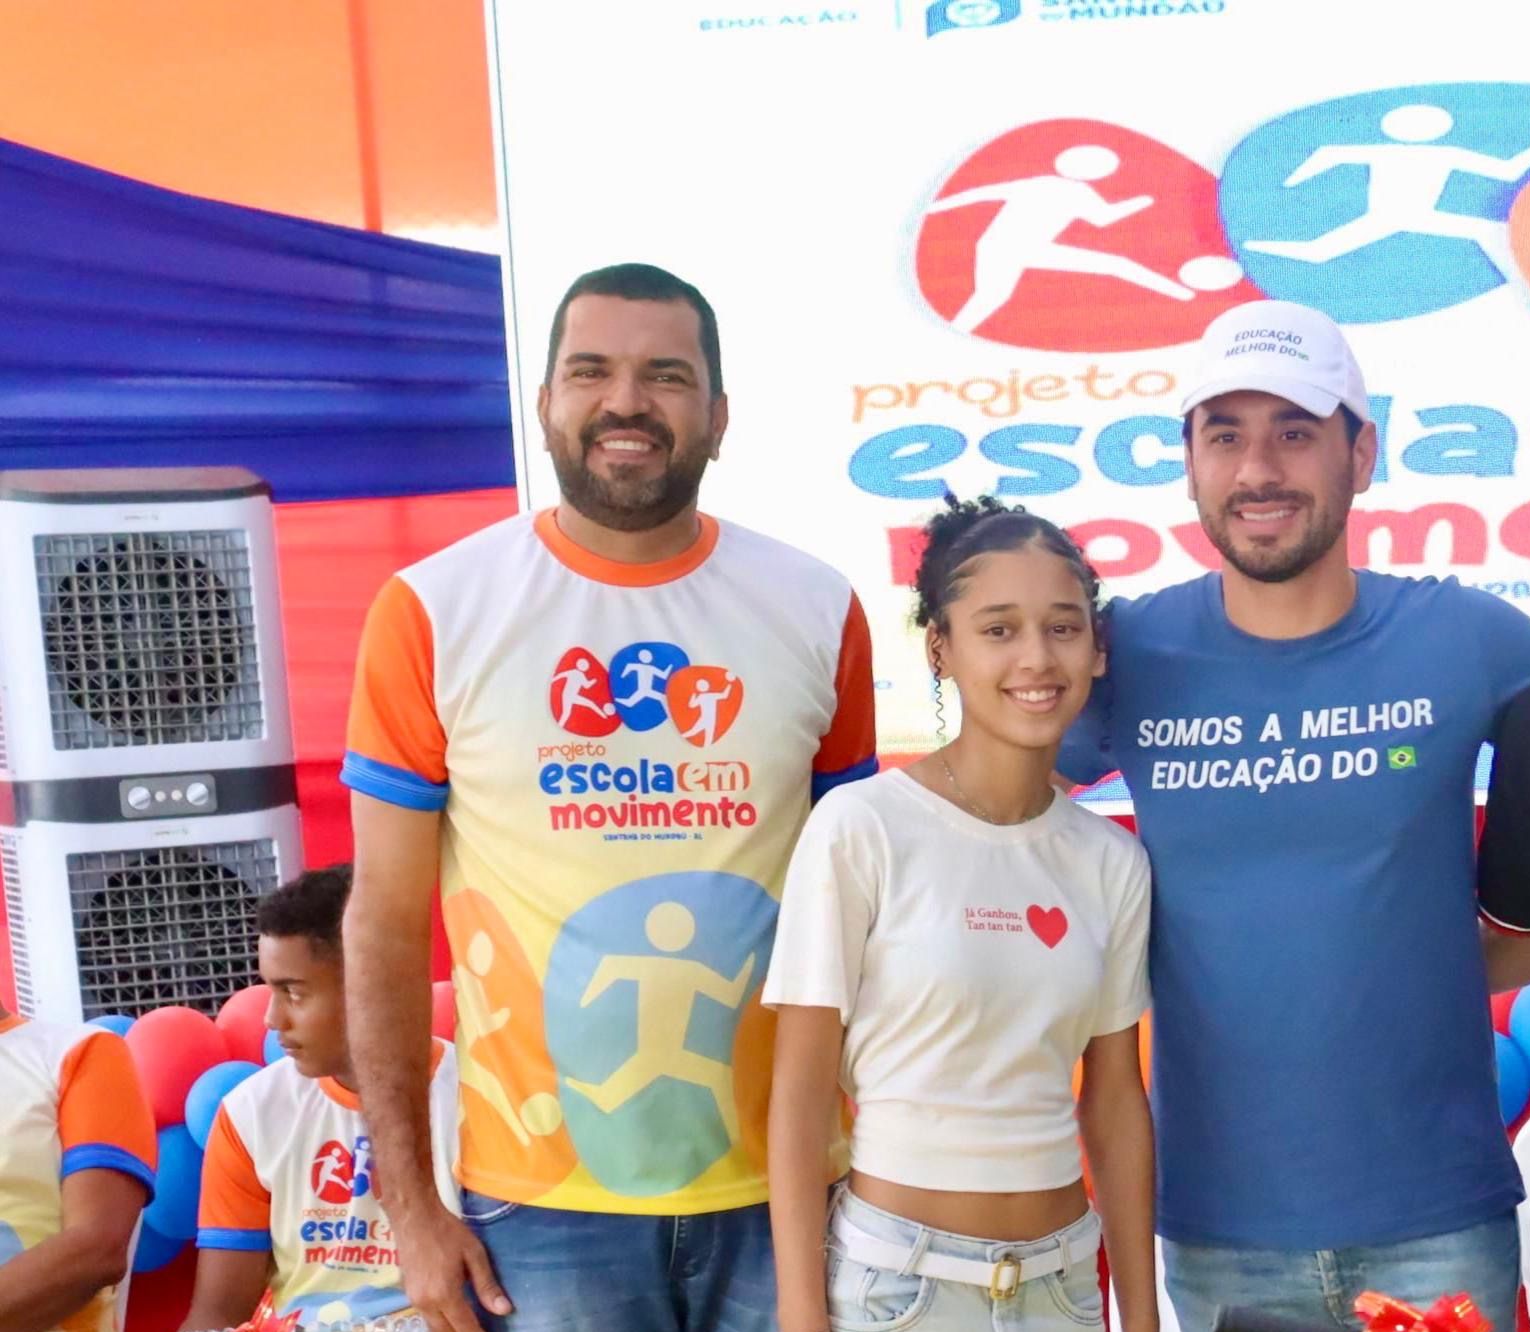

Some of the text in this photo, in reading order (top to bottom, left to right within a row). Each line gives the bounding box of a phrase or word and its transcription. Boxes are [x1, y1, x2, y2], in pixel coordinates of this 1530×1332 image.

[1224, 341, 1297, 359] MELHOR DO
[1234, 328, 1304, 346] EDUCAÇÃO
[851, 364, 1178, 423] projeto
[848, 394, 1519, 500] escla
[1137, 698, 1434, 748] SOMOS A MELHOR
[537, 741, 607, 763] projeto
[1151, 747, 1379, 793] EDUCAÇÃO DO
[539, 758, 751, 795] escola em
[549, 794, 758, 831] movimento
[967, 920, 1023, 933] Tan tan tan
[977, 908, 1022, 920] Ganhou,
